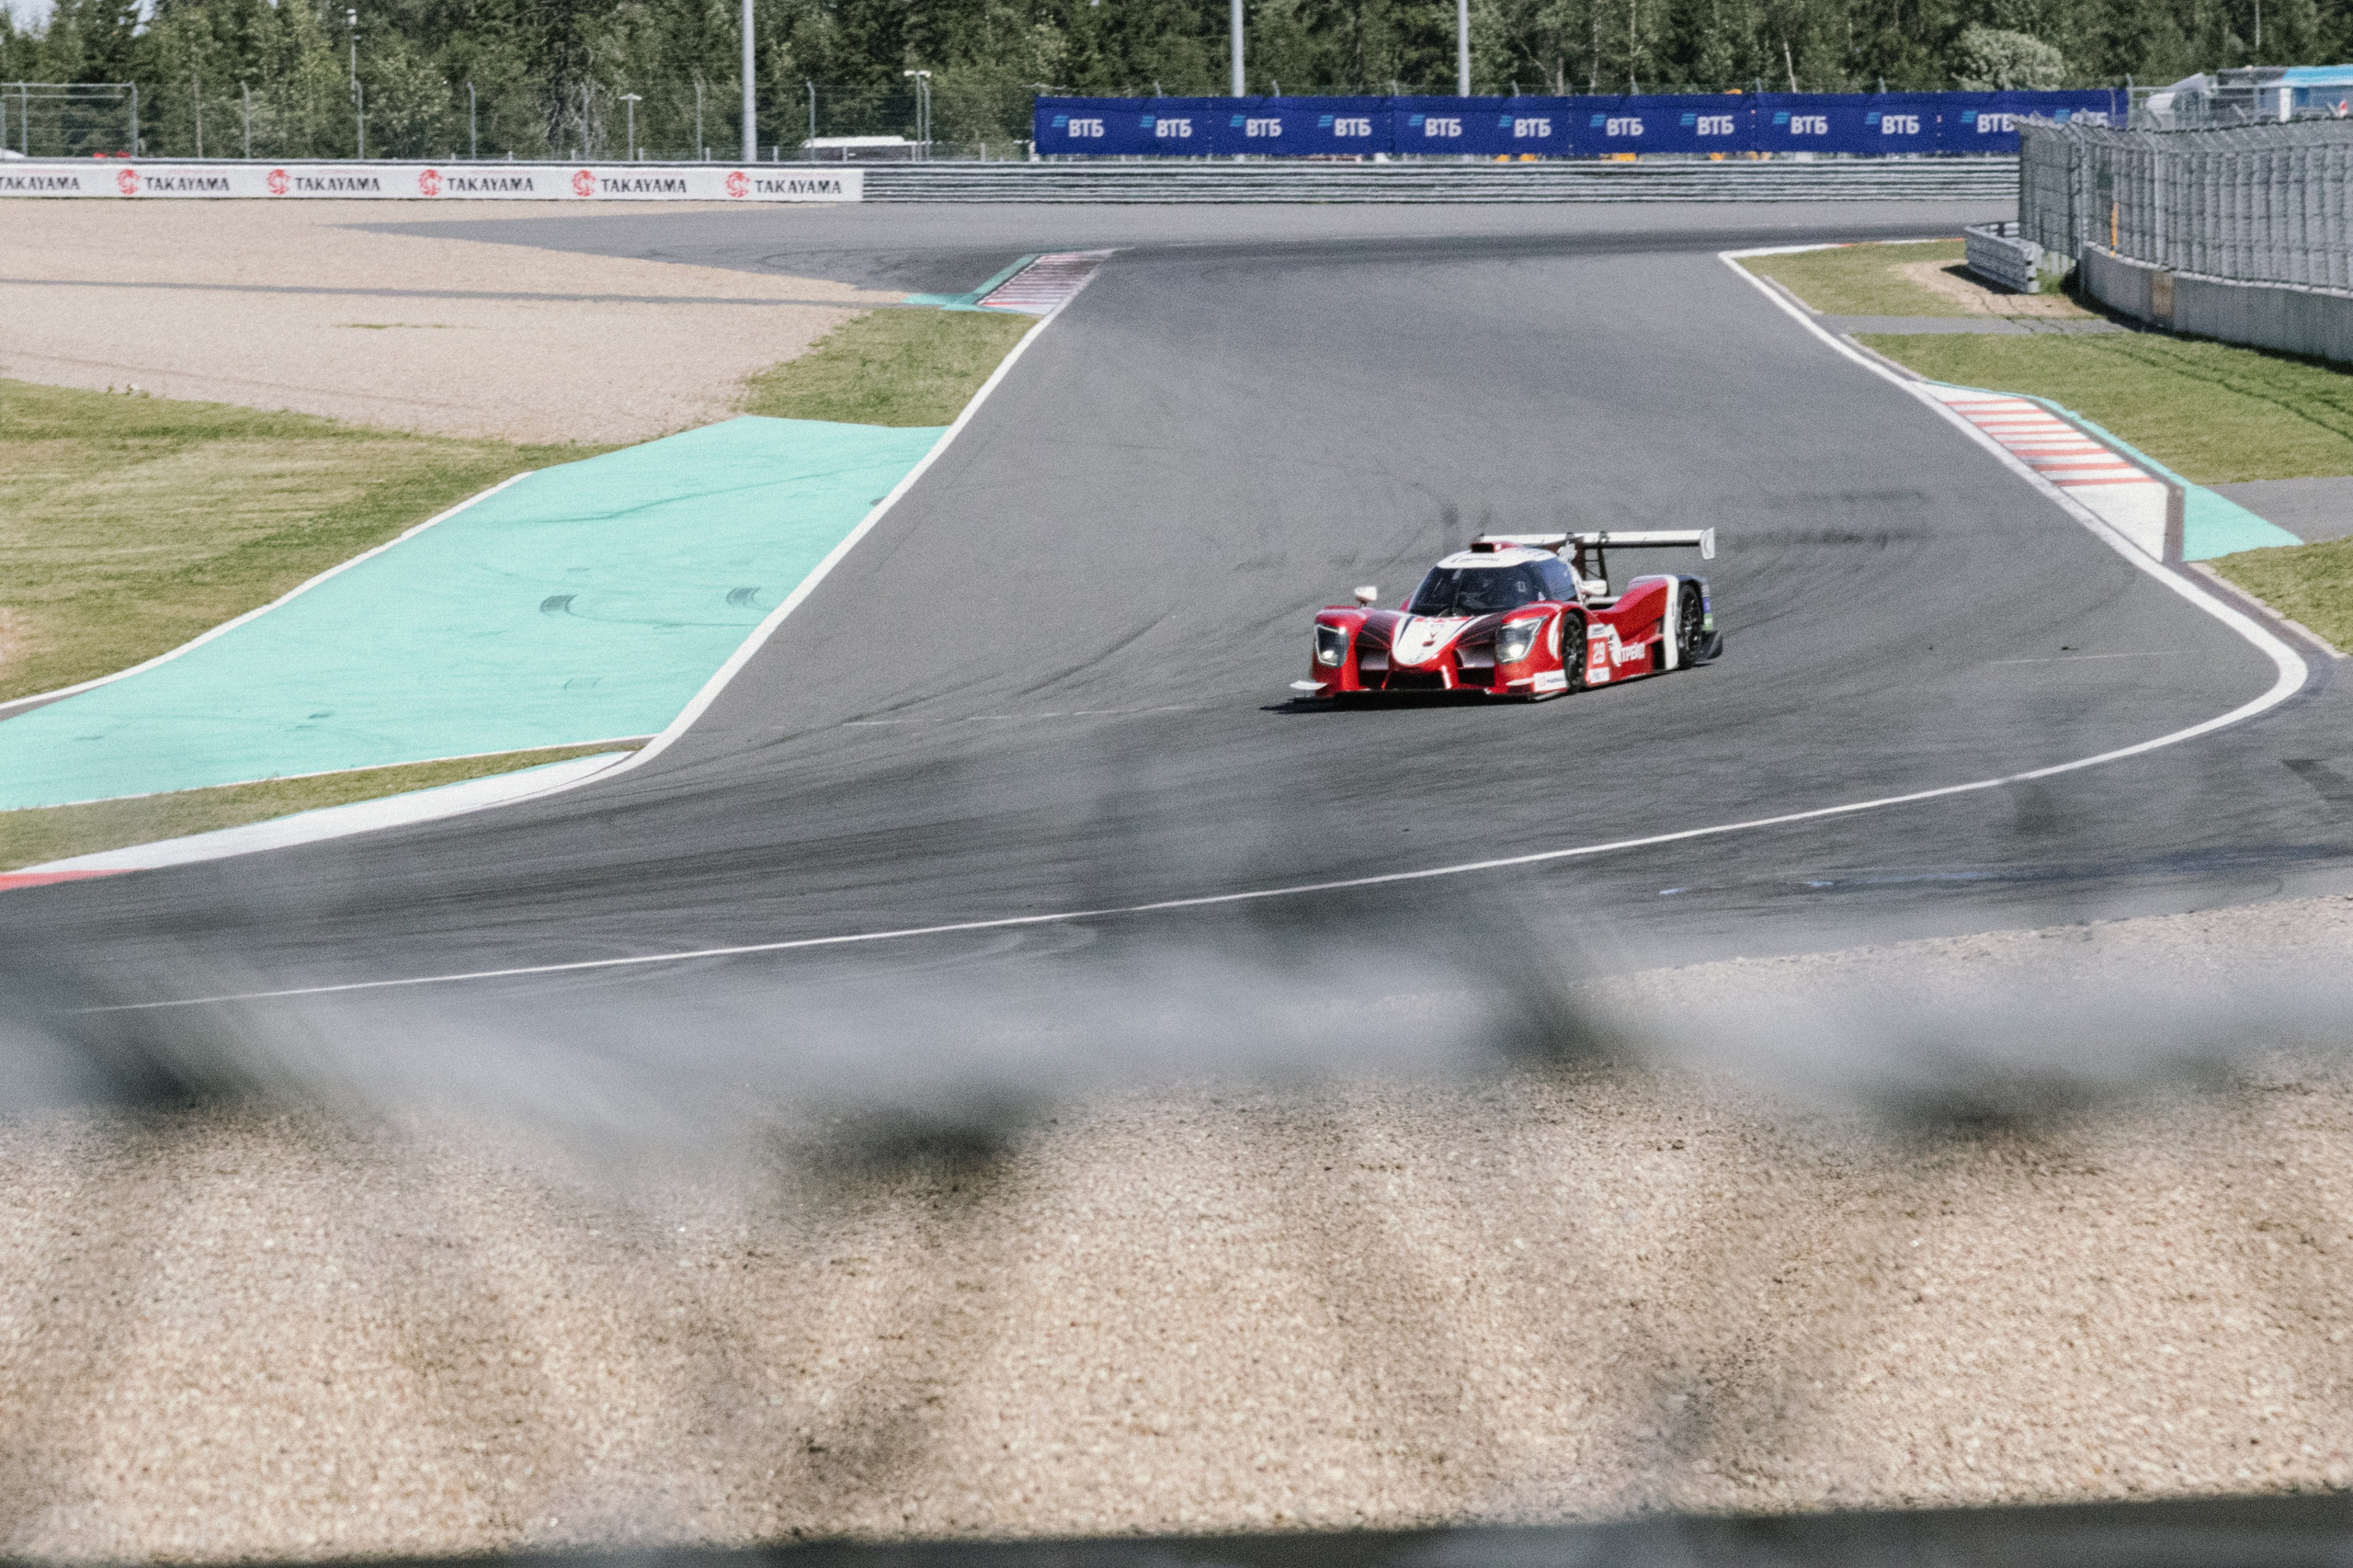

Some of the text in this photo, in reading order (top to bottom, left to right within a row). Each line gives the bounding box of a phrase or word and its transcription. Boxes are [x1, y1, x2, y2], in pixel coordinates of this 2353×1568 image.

[1069, 119, 1103, 137] ВТБ
[1156, 119, 1191, 137] ВТБ
[1246, 119, 1281, 137] ВТБ
[1335, 118, 1370, 136] ВТБ
[1426, 118, 1461, 137] ВТБ
[1515, 119, 1550, 137] ВТБ
[1607, 118, 1643, 136] ВТБ
[1698, 115, 1733, 135] ВТБ
[1790, 116, 1827, 134] ВТБ
[1881, 115, 1919, 134] ВТБ
[1978, 113, 2016, 133] ВТБ
[145, 176, 229, 190] TAKAYAMA
[295, 177, 380, 190] TAKAYAMA
[448, 178, 533, 190] TAKAYAMA
[601, 179, 687, 192] TAKAYAMA
[756, 179, 841, 193] TAKAYAMA
[1592, 642, 1606, 665] 29
